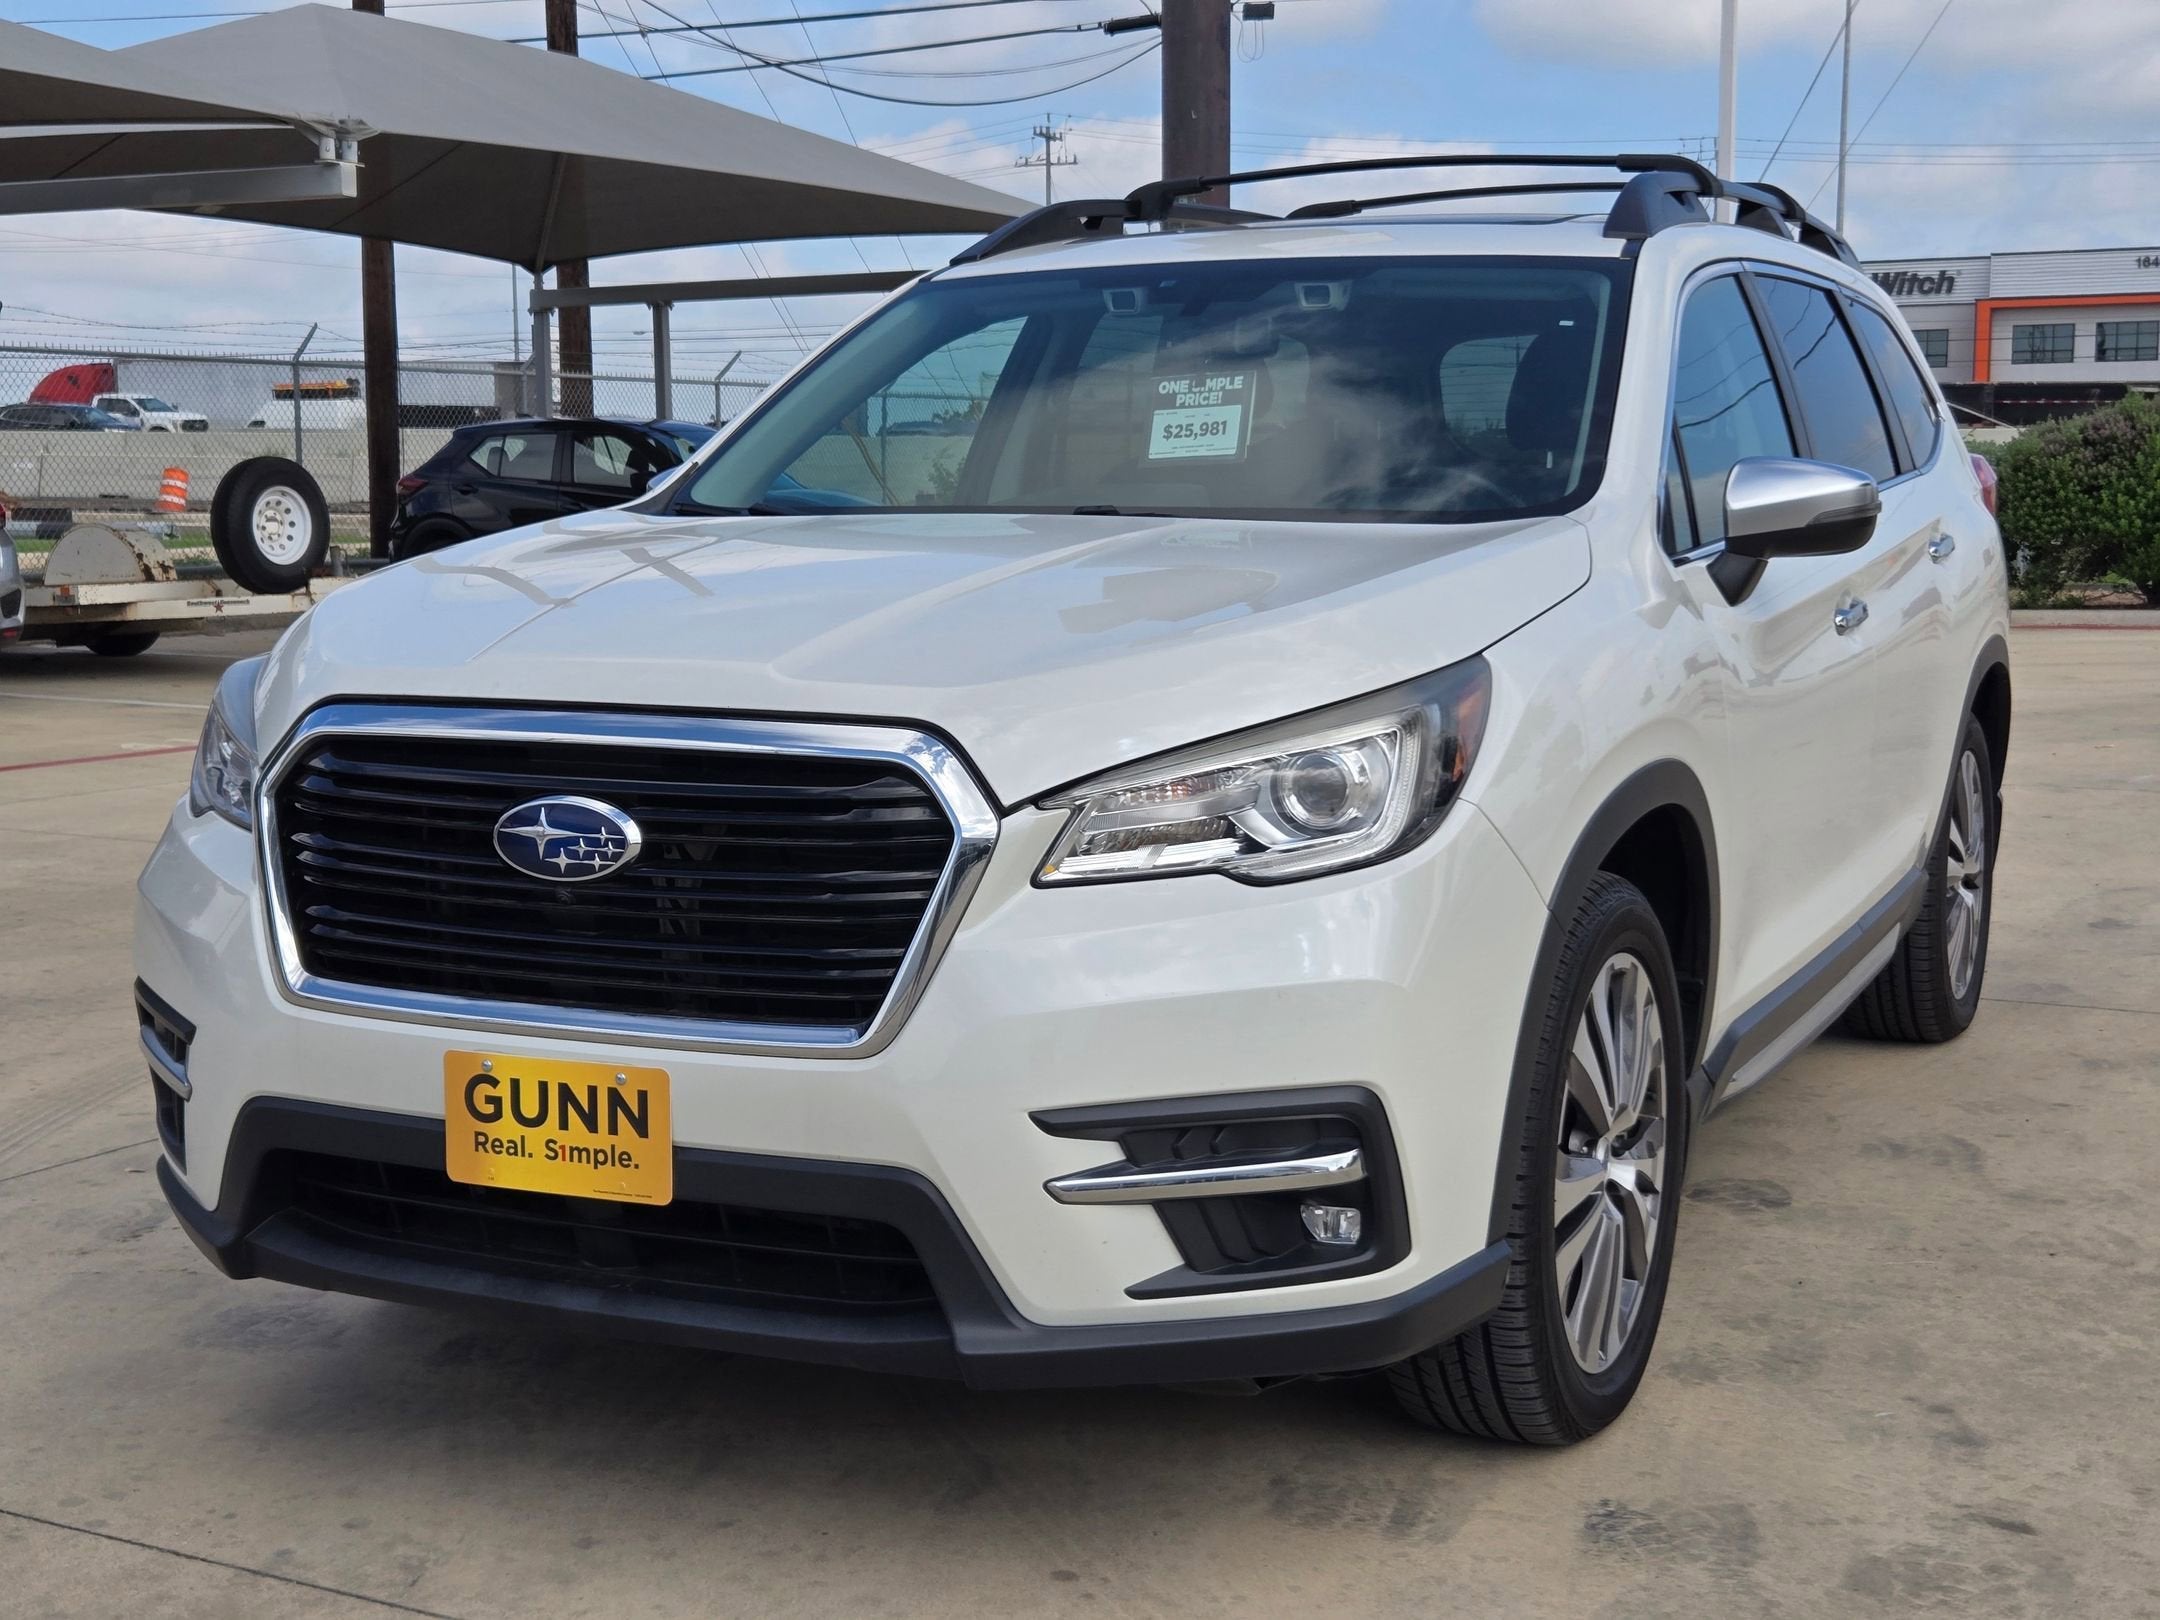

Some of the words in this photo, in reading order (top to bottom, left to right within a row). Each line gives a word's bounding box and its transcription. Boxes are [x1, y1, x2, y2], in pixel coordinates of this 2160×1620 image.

[1872, 270, 1955, 295] Witch
[1158, 380, 1190, 394] ONE
[1192, 376, 1244, 393] MPLE
[1176, 392, 1223, 407] PRICE!
[1162, 420, 1228, 441] $25,981
[464, 1073, 649, 1139] GUNN
[474, 1131, 533, 1158] Real.
